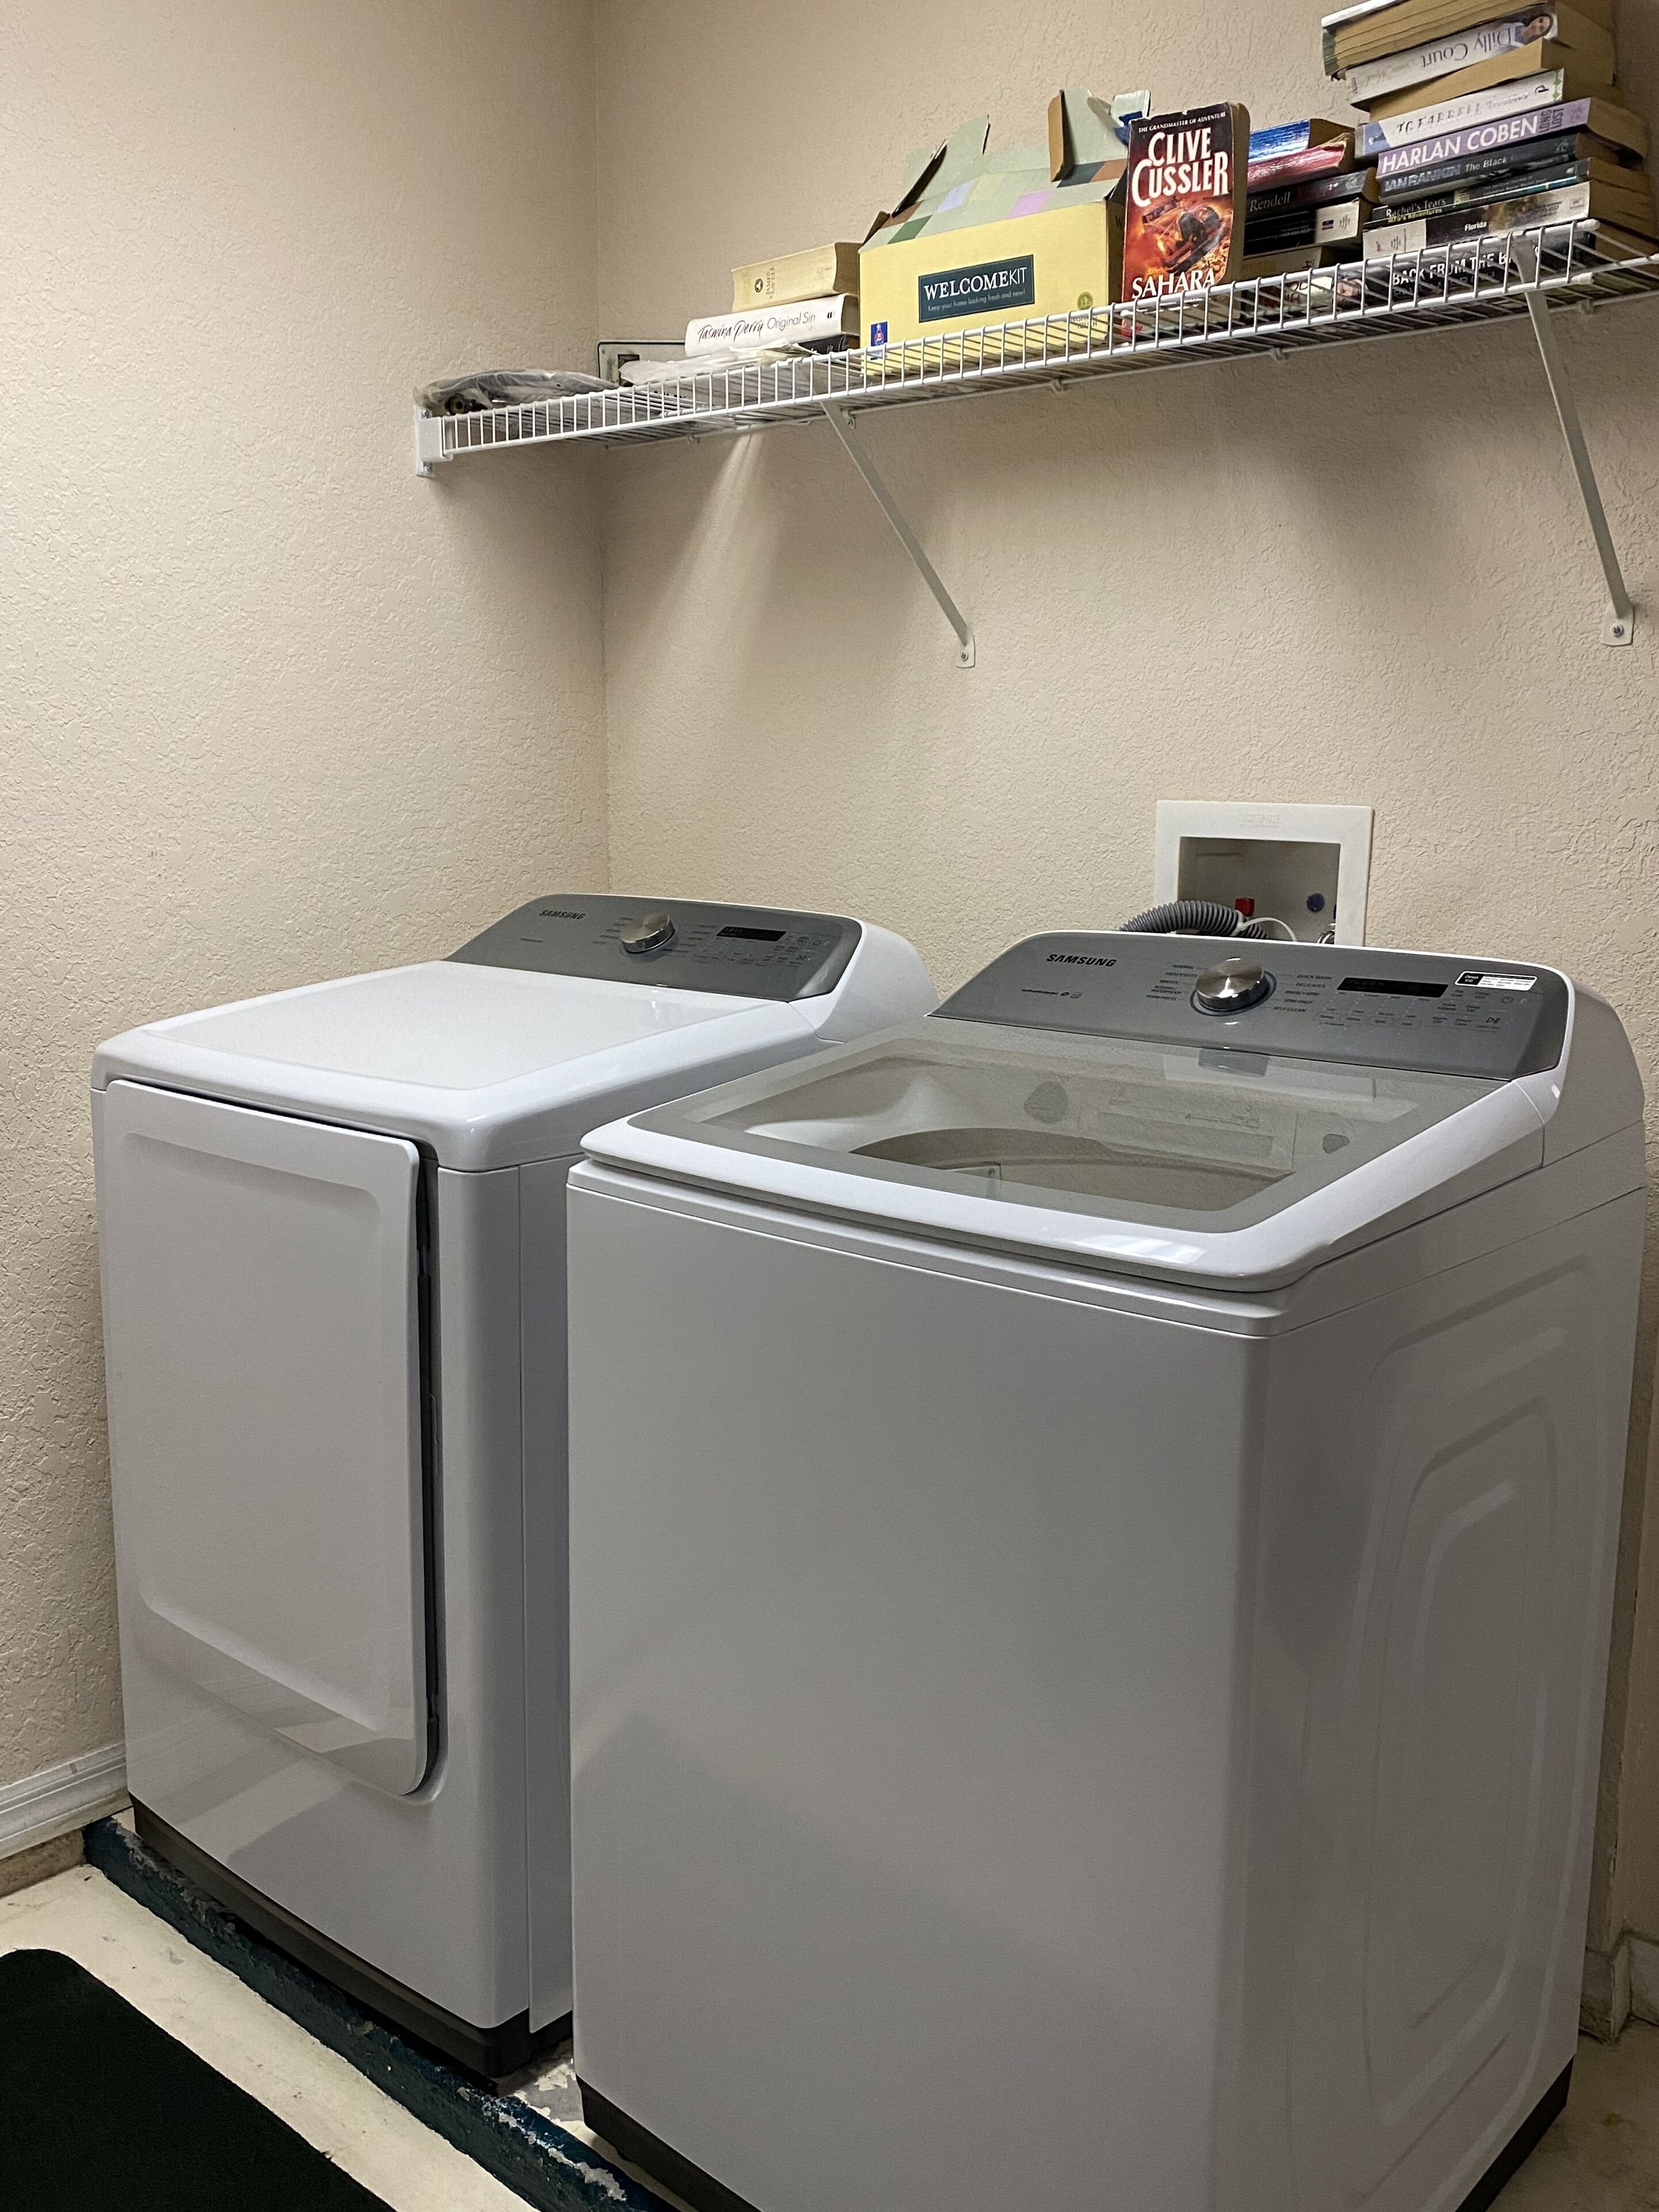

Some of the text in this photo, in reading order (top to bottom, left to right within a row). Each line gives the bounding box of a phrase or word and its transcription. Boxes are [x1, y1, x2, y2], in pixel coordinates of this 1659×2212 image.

[1421, 28, 1512, 67] Dilly Court
[1149, 119, 1188, 131] GRANDMASTER
[1539, 109, 1552, 133] LONG
[1551, 108, 1564, 129] LOST
[1148, 127, 1212, 166] CLIVE
[1382, 115, 1539, 173] HARLAN COBEN
[1465, 162, 1481, 172] The
[1483, 156, 1508, 168] Black
[1131, 151, 1230, 208] CUSSLER
[1249, 191, 1291, 212] Rendell
[1386, 198, 1446, 217] Rachel's Tears
[1464, 221, 1487, 232] Florida
[1392, 267, 1426, 286] BACK
[1469, 253, 1495, 270] THE
[1131, 268, 1215, 299] SAHARA
[941, 302, 952, 311] your
[968, 296, 987, 305] looking
[697, 312, 816, 344] Tasmina Perry Original Sin
[539, 910, 586, 919] SAMSUNG
[1046, 954, 1117, 967] SAMSUNG
